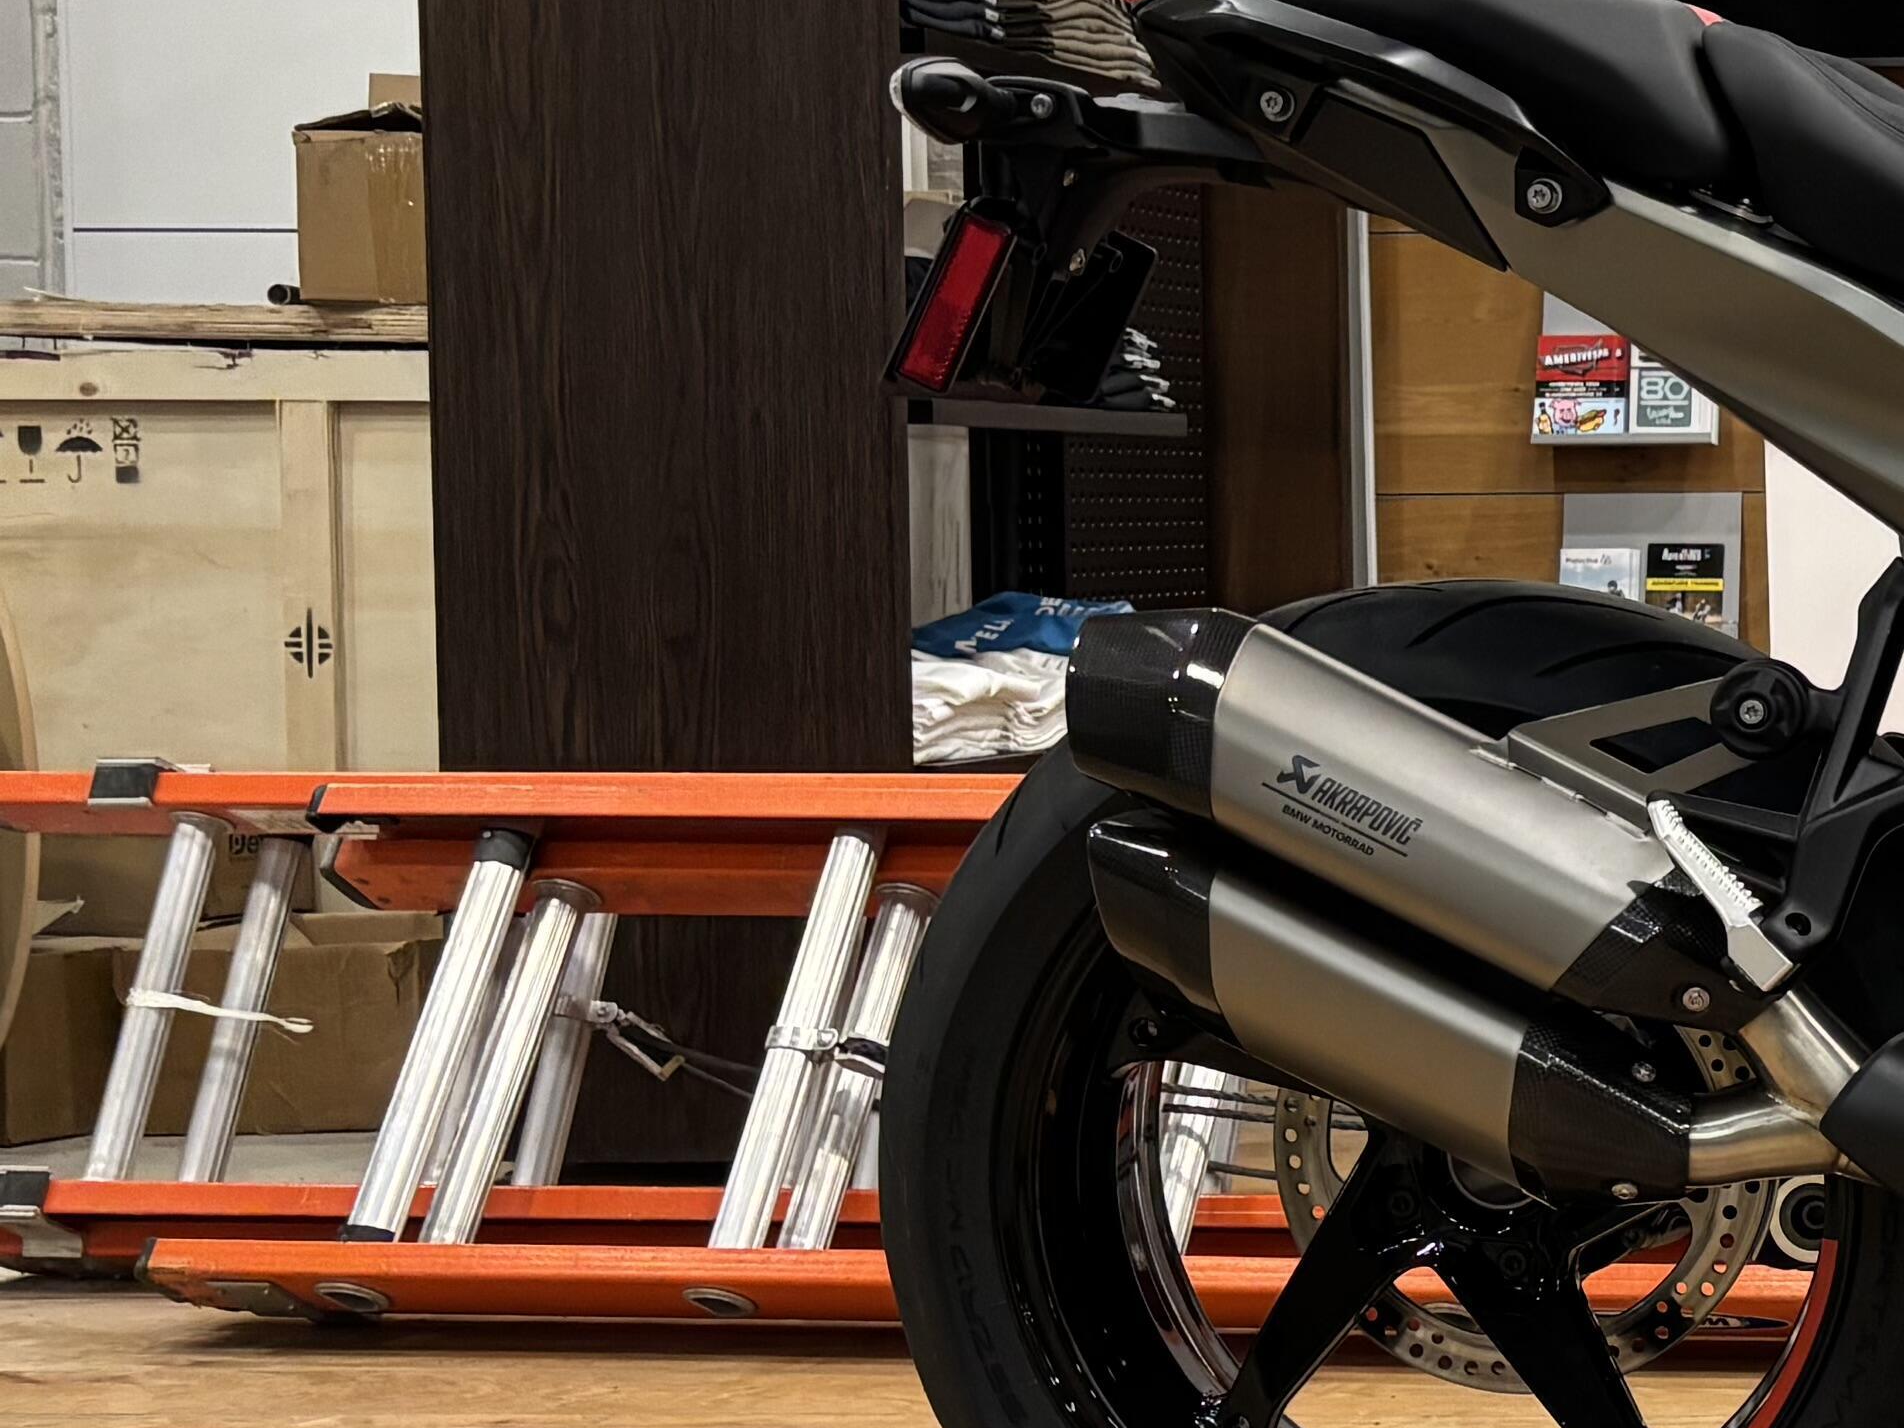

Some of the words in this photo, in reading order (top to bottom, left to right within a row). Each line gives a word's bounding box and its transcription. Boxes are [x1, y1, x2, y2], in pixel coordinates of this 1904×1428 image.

[1640, 376, 1691, 401] 80
[1281, 803, 1312, 825] BMW
[1311, 819, 1375, 857] MOTORRAD
